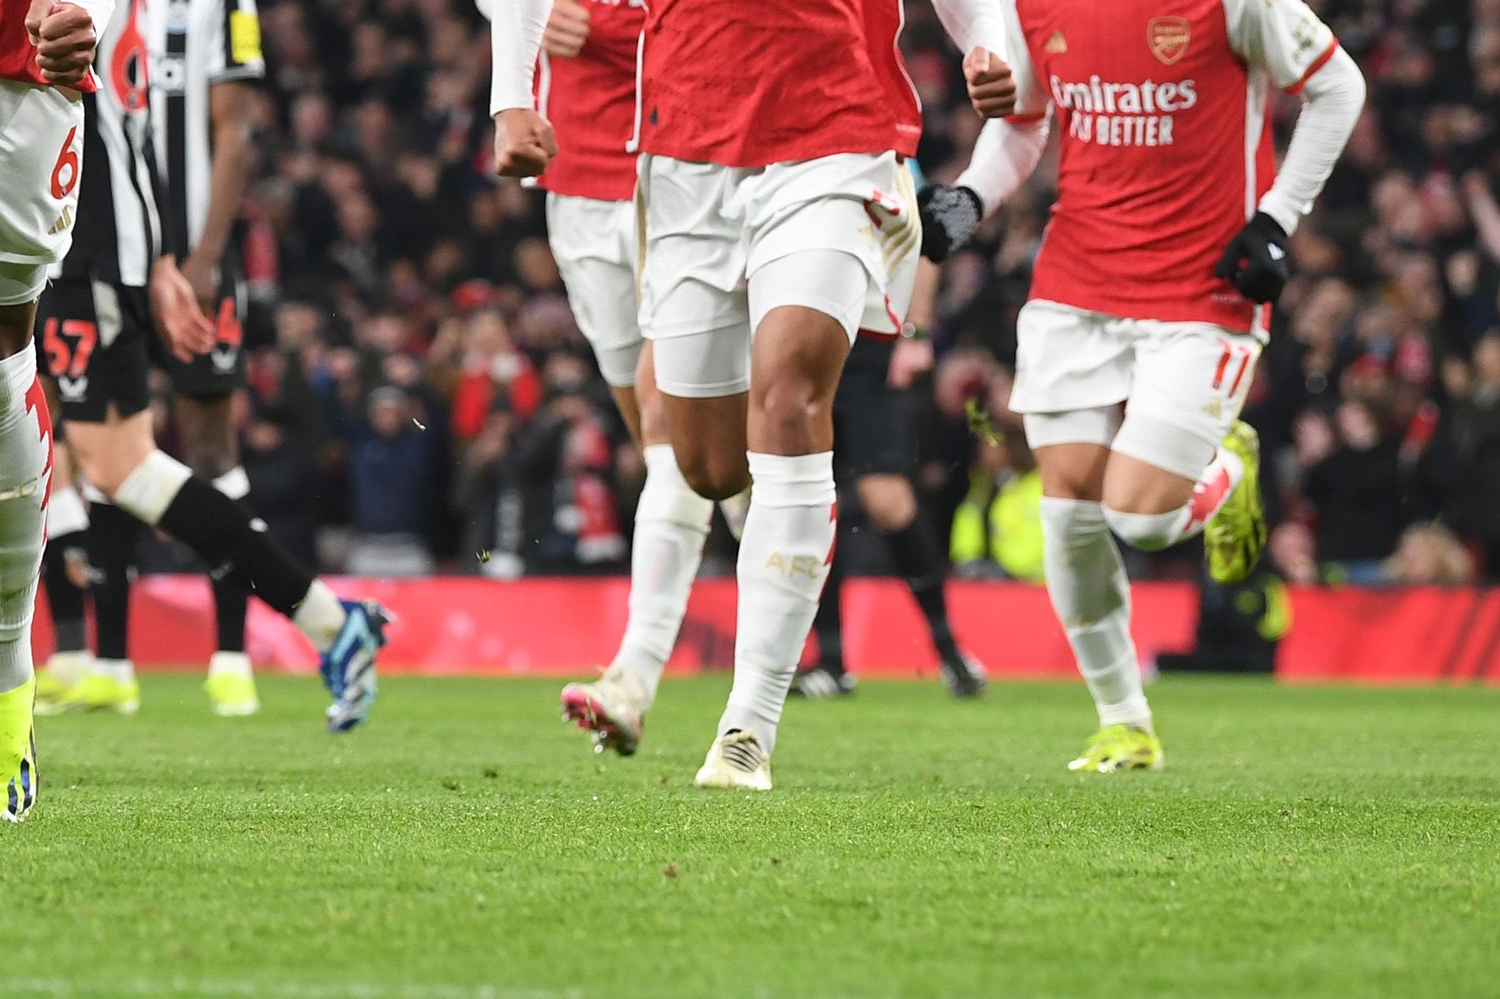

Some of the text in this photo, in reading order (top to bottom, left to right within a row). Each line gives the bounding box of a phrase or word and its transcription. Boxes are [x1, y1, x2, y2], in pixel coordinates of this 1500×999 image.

[1096, 114, 1174, 147] BETTER
[51, 124, 78, 200] 6
[43, 317, 98, 378] 67
[1213, 338, 1251, 399] 11
